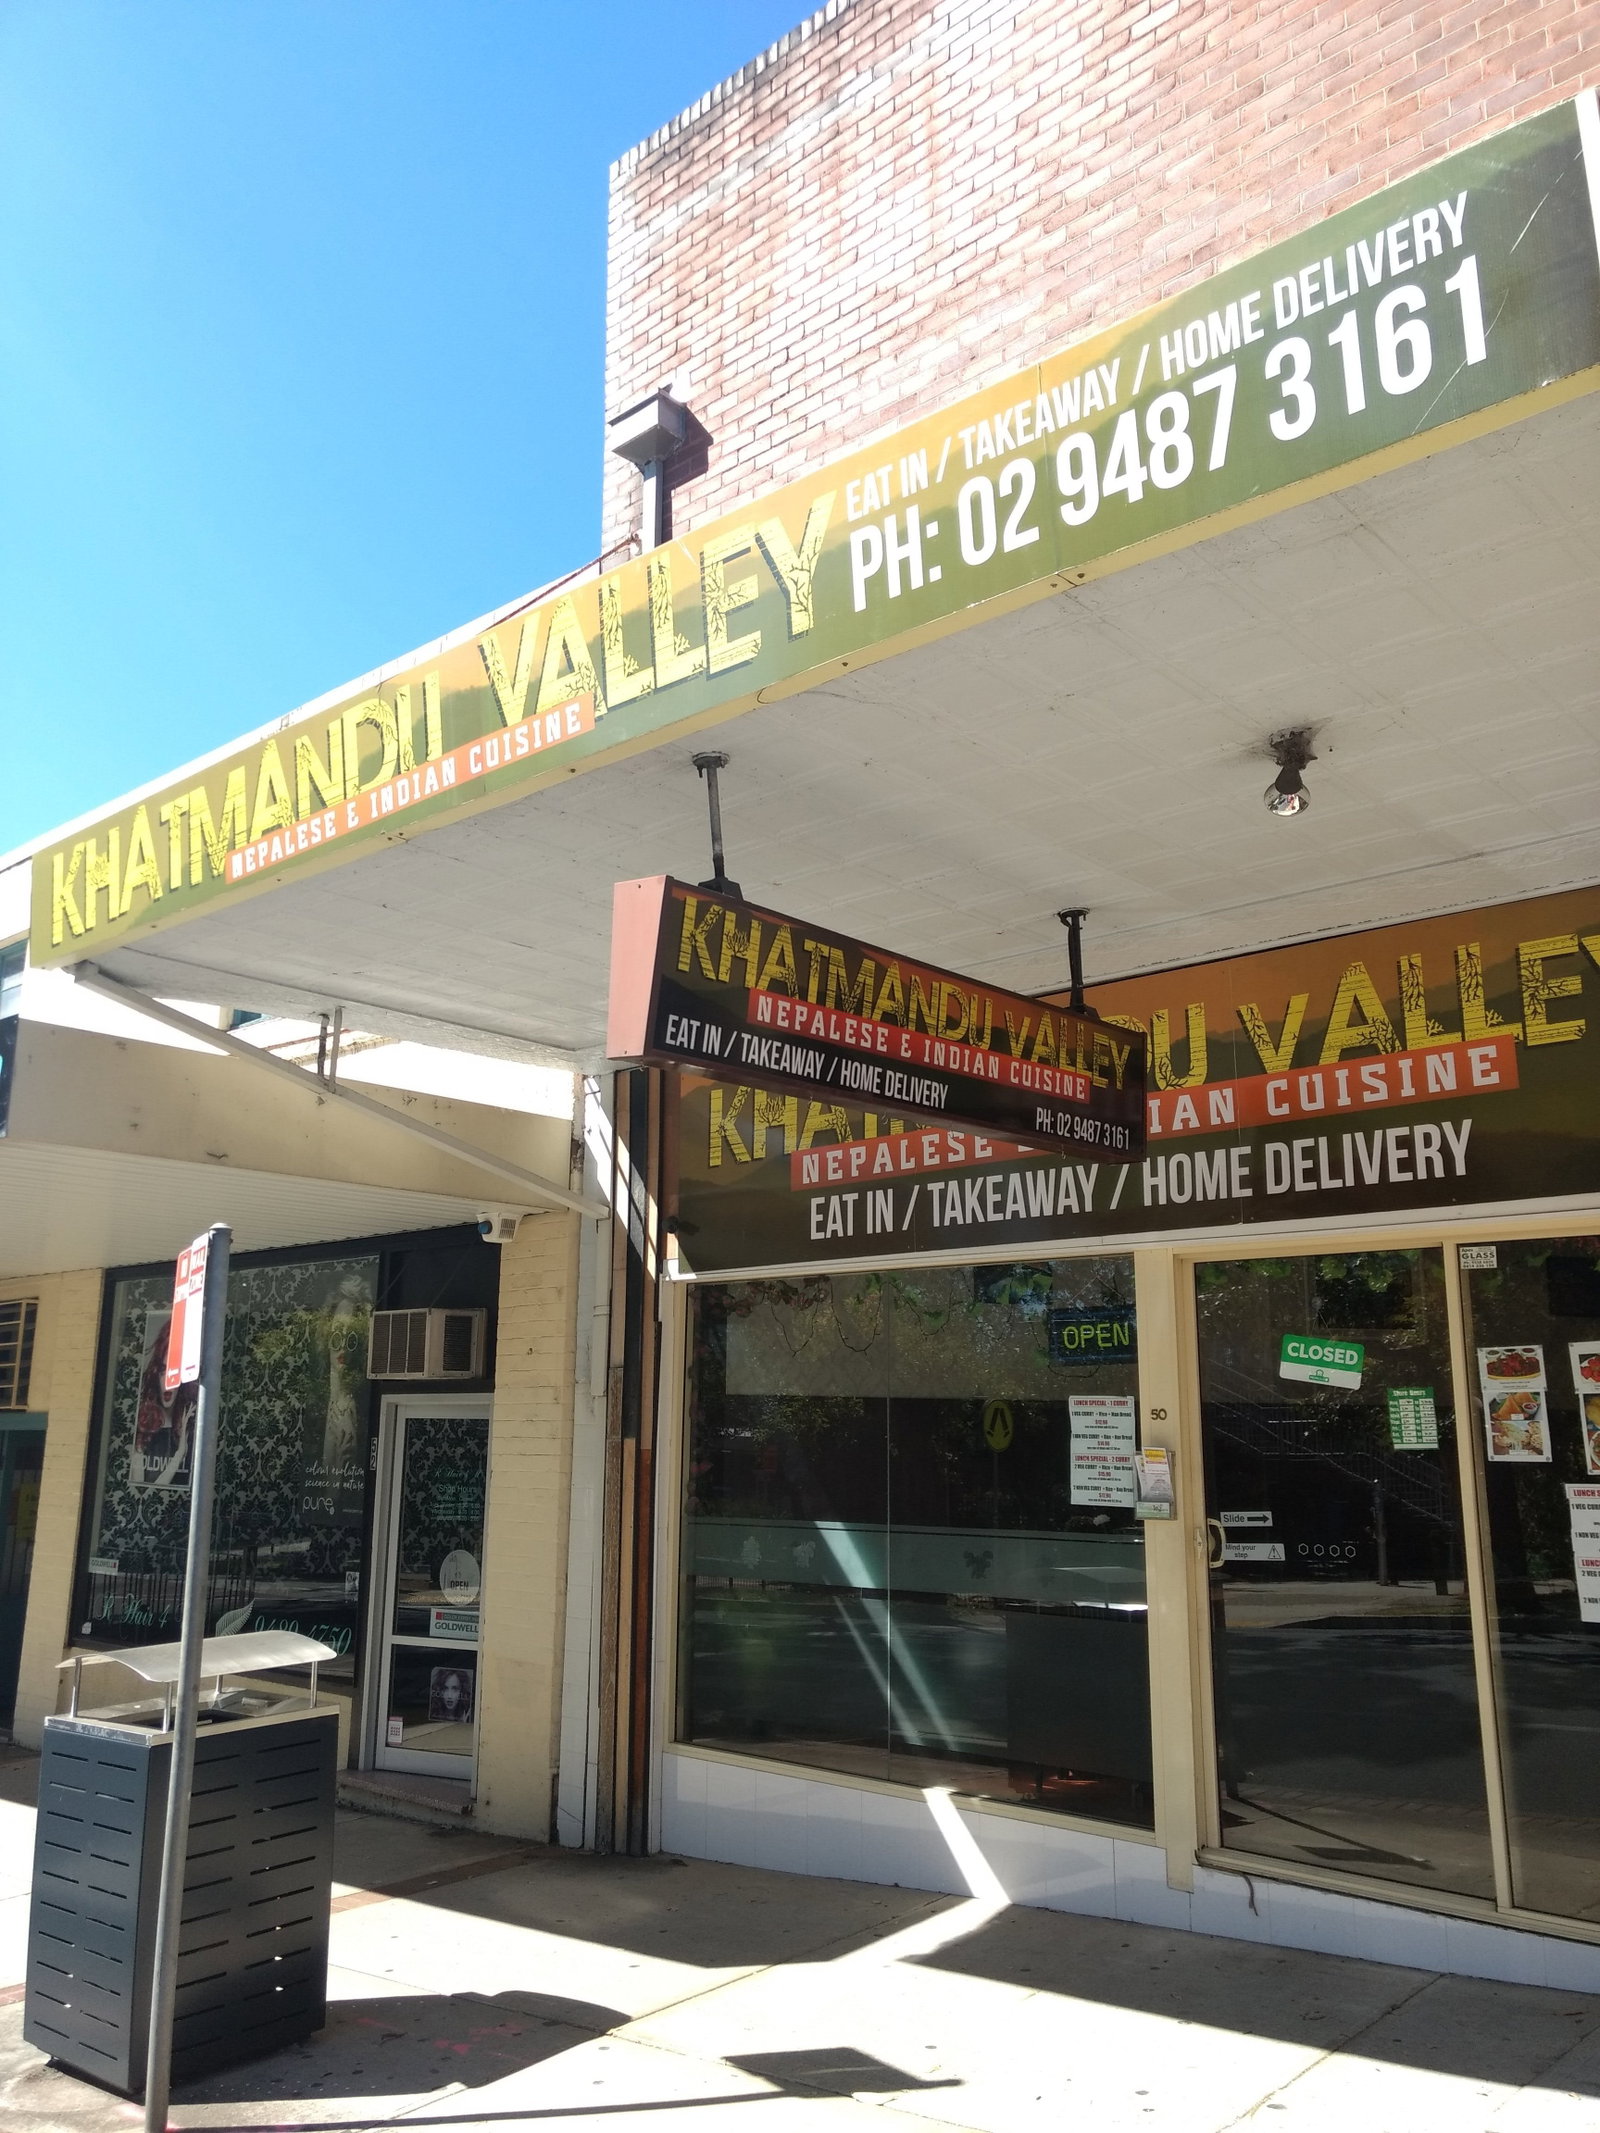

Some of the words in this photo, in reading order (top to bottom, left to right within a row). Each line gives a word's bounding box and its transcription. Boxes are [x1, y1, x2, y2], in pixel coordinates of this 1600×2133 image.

[846, 466, 893, 523] EAT
[899, 450, 928, 494] IN
[961, 358, 1121, 460] TAKEAWAY
[1160, 290, 1265, 369] HOME
[1273, 191, 1469, 332] DELIVERY
[848, 504, 942, 612] PH:
[957, 457, 1040, 567] 02
[1056, 364, 1239, 527] 9487
[1264, 255, 1488, 443] 3161
[51, 670, 444, 950] KHATMANDU
[478, 490, 838, 732] VALLEY
[231, 816, 338, 880] NEPALESE
[369, 757, 459, 820] INDIAN
[468, 702, 584, 775] CUISINE
[677, 894, 993, 1049] KHATMANDU
[1004, 1008, 1132, 1090] VALLEY
[664, 1014, 700, 1049] EAT
[702, 1023, 721, 1056] IN
[741, 1032, 824, 1083] TAKEAWAY
[840, 1060, 883, 1096] HOME
[884, 1071, 950, 1110] DELIVERY
[756, 995, 888, 1055] NEPALESE
[923, 1044, 1001, 1081] INDIAN
[1009, 1066, 1087, 1102] CUISINE
[802, 1131, 993, 1185] NEPALESE
[1265, 1043, 1501, 1118] CUISINE
[1035, 1106, 1055, 1136] PH:
[1056, 1112, 1071, 1137] 02
[1072, 1115, 1100, 1145] 9487
[1100, 1118, 1130, 1150] 3161
[810, 1194, 859, 1240] EAT
[866, 1185, 894, 1235] IN
[927, 1163, 1099, 1229] TAKEAWAY
[1143, 1145, 1253, 1208] HOME
[1265, 1118, 1473, 1196] DELIVERY
[1461, 1252, 1495, 1260] GLASS
[1063, 1321, 1130, 1349] OPEN
[1287, 1342, 1359, 1366] CLOSED
[1151, 1408, 1168, 1421] 50
[1223, 1514, 1245, 1523] Slide
[1573, 1489, 1596, 1497] LUNCH
[450, 1580, 469, 1591] OPEN
[434, 1621, 479, 1633] GOLDWELL
